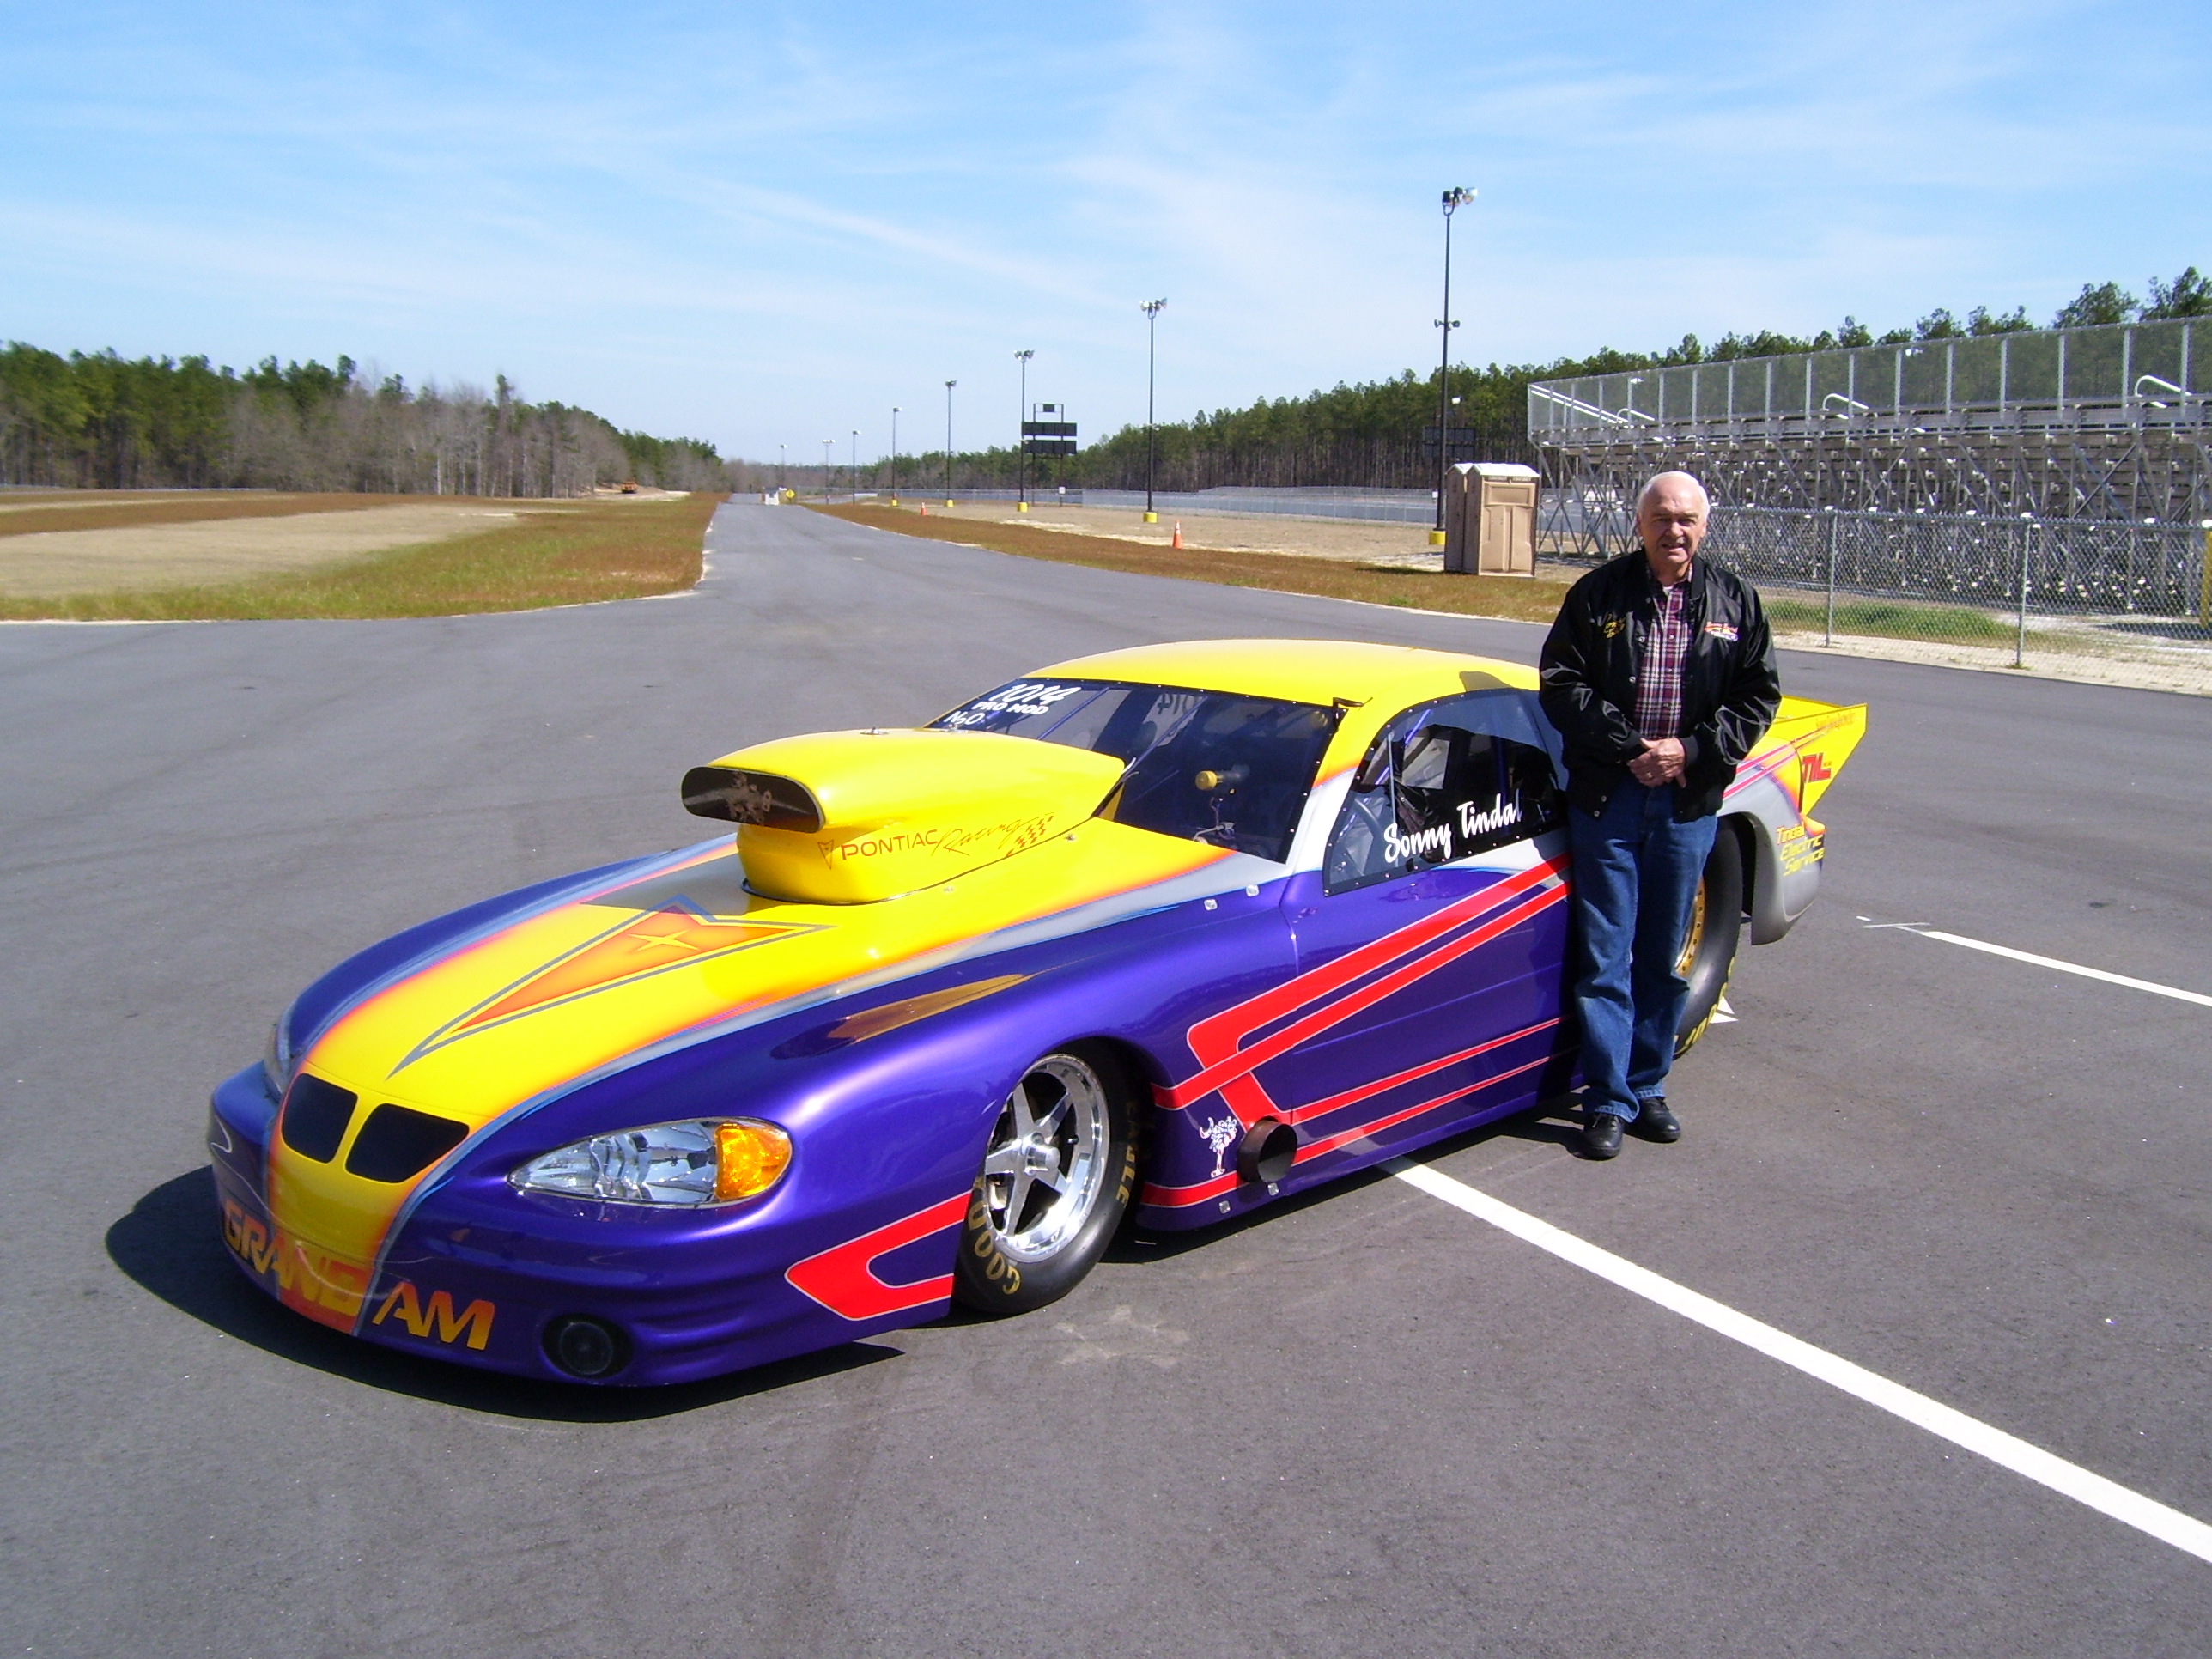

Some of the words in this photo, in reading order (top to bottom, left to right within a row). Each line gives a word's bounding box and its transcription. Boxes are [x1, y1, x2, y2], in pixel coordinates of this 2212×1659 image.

[971, 701, 1008, 711] PRO
[1006, 702, 1049, 715] MOD
[988, 684, 1082, 705] 1014
[840, 829, 939, 861] PONTIAC
[931, 817, 1034, 857] Racing
[1383, 822, 1452, 864] Sonny
[223, 1199, 375, 1316] GRAND
[372, 1280, 495, 1351] AM
